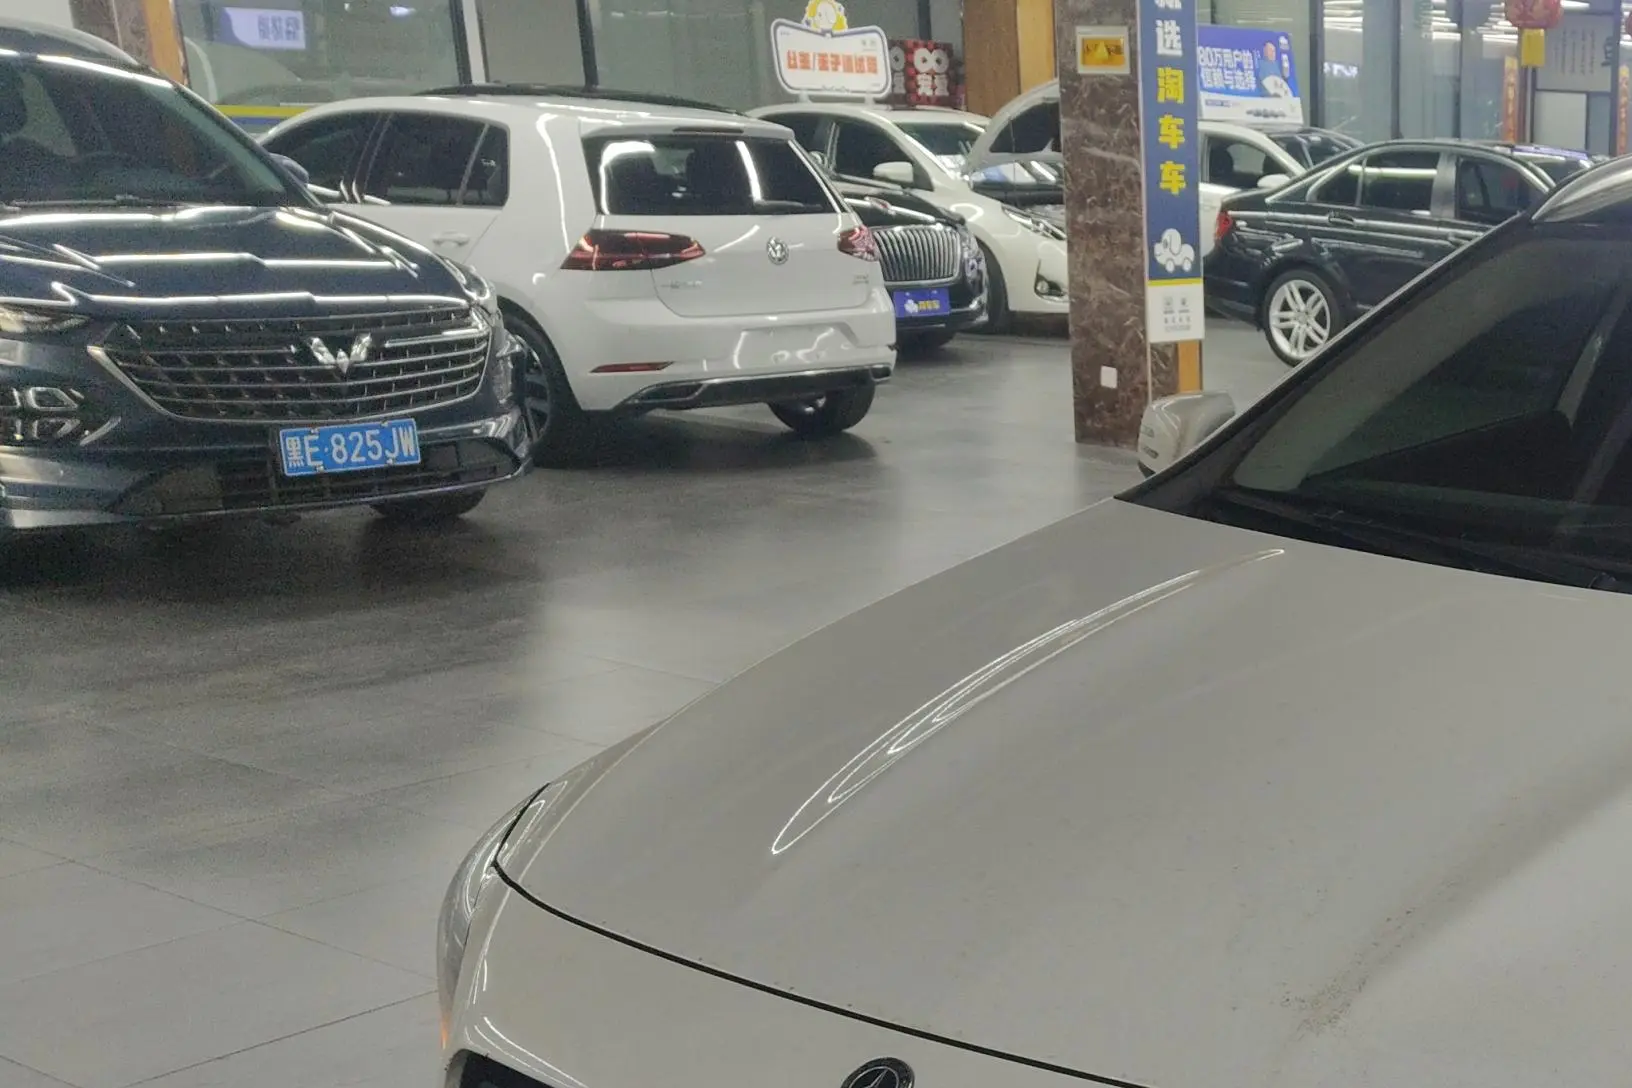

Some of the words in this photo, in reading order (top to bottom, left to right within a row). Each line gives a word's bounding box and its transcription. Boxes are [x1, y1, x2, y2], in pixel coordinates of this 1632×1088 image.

[1198, 46, 1254, 69] 80万用户的
[1201, 67, 1257, 90] 信赖与选择
[1155, 0, 1187, 195] 选淘车车
